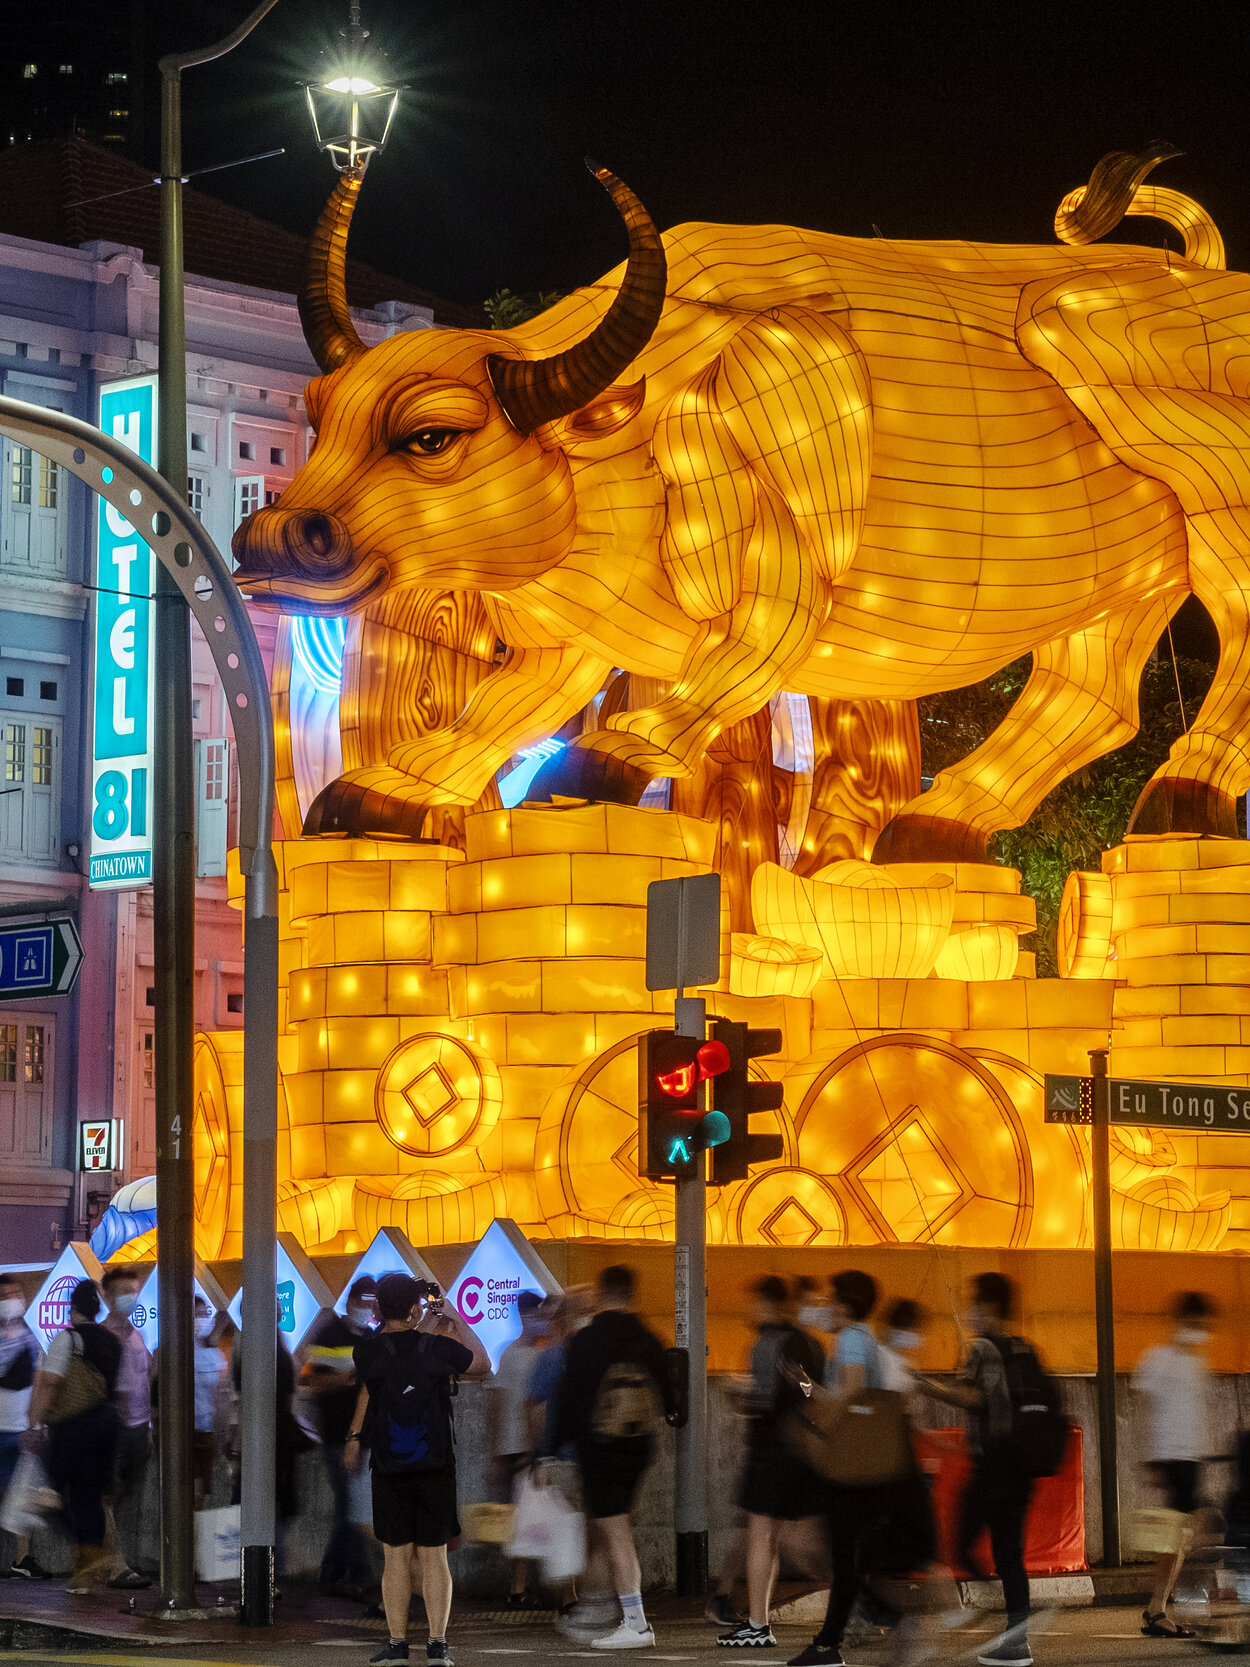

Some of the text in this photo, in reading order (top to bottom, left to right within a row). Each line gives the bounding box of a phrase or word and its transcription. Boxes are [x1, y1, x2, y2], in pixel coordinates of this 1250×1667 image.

[93, 767, 146, 840] 81
[91, 856, 145, 879] CHINATOWN
[1119, 1085, 1146, 1113] Eu
[1159, 1088, 1214, 1124] Tong
[487, 1276, 520, 1290] Central
[487, 1292, 518, 1306] Singap
[487, 1307, 509, 1320] CDC
